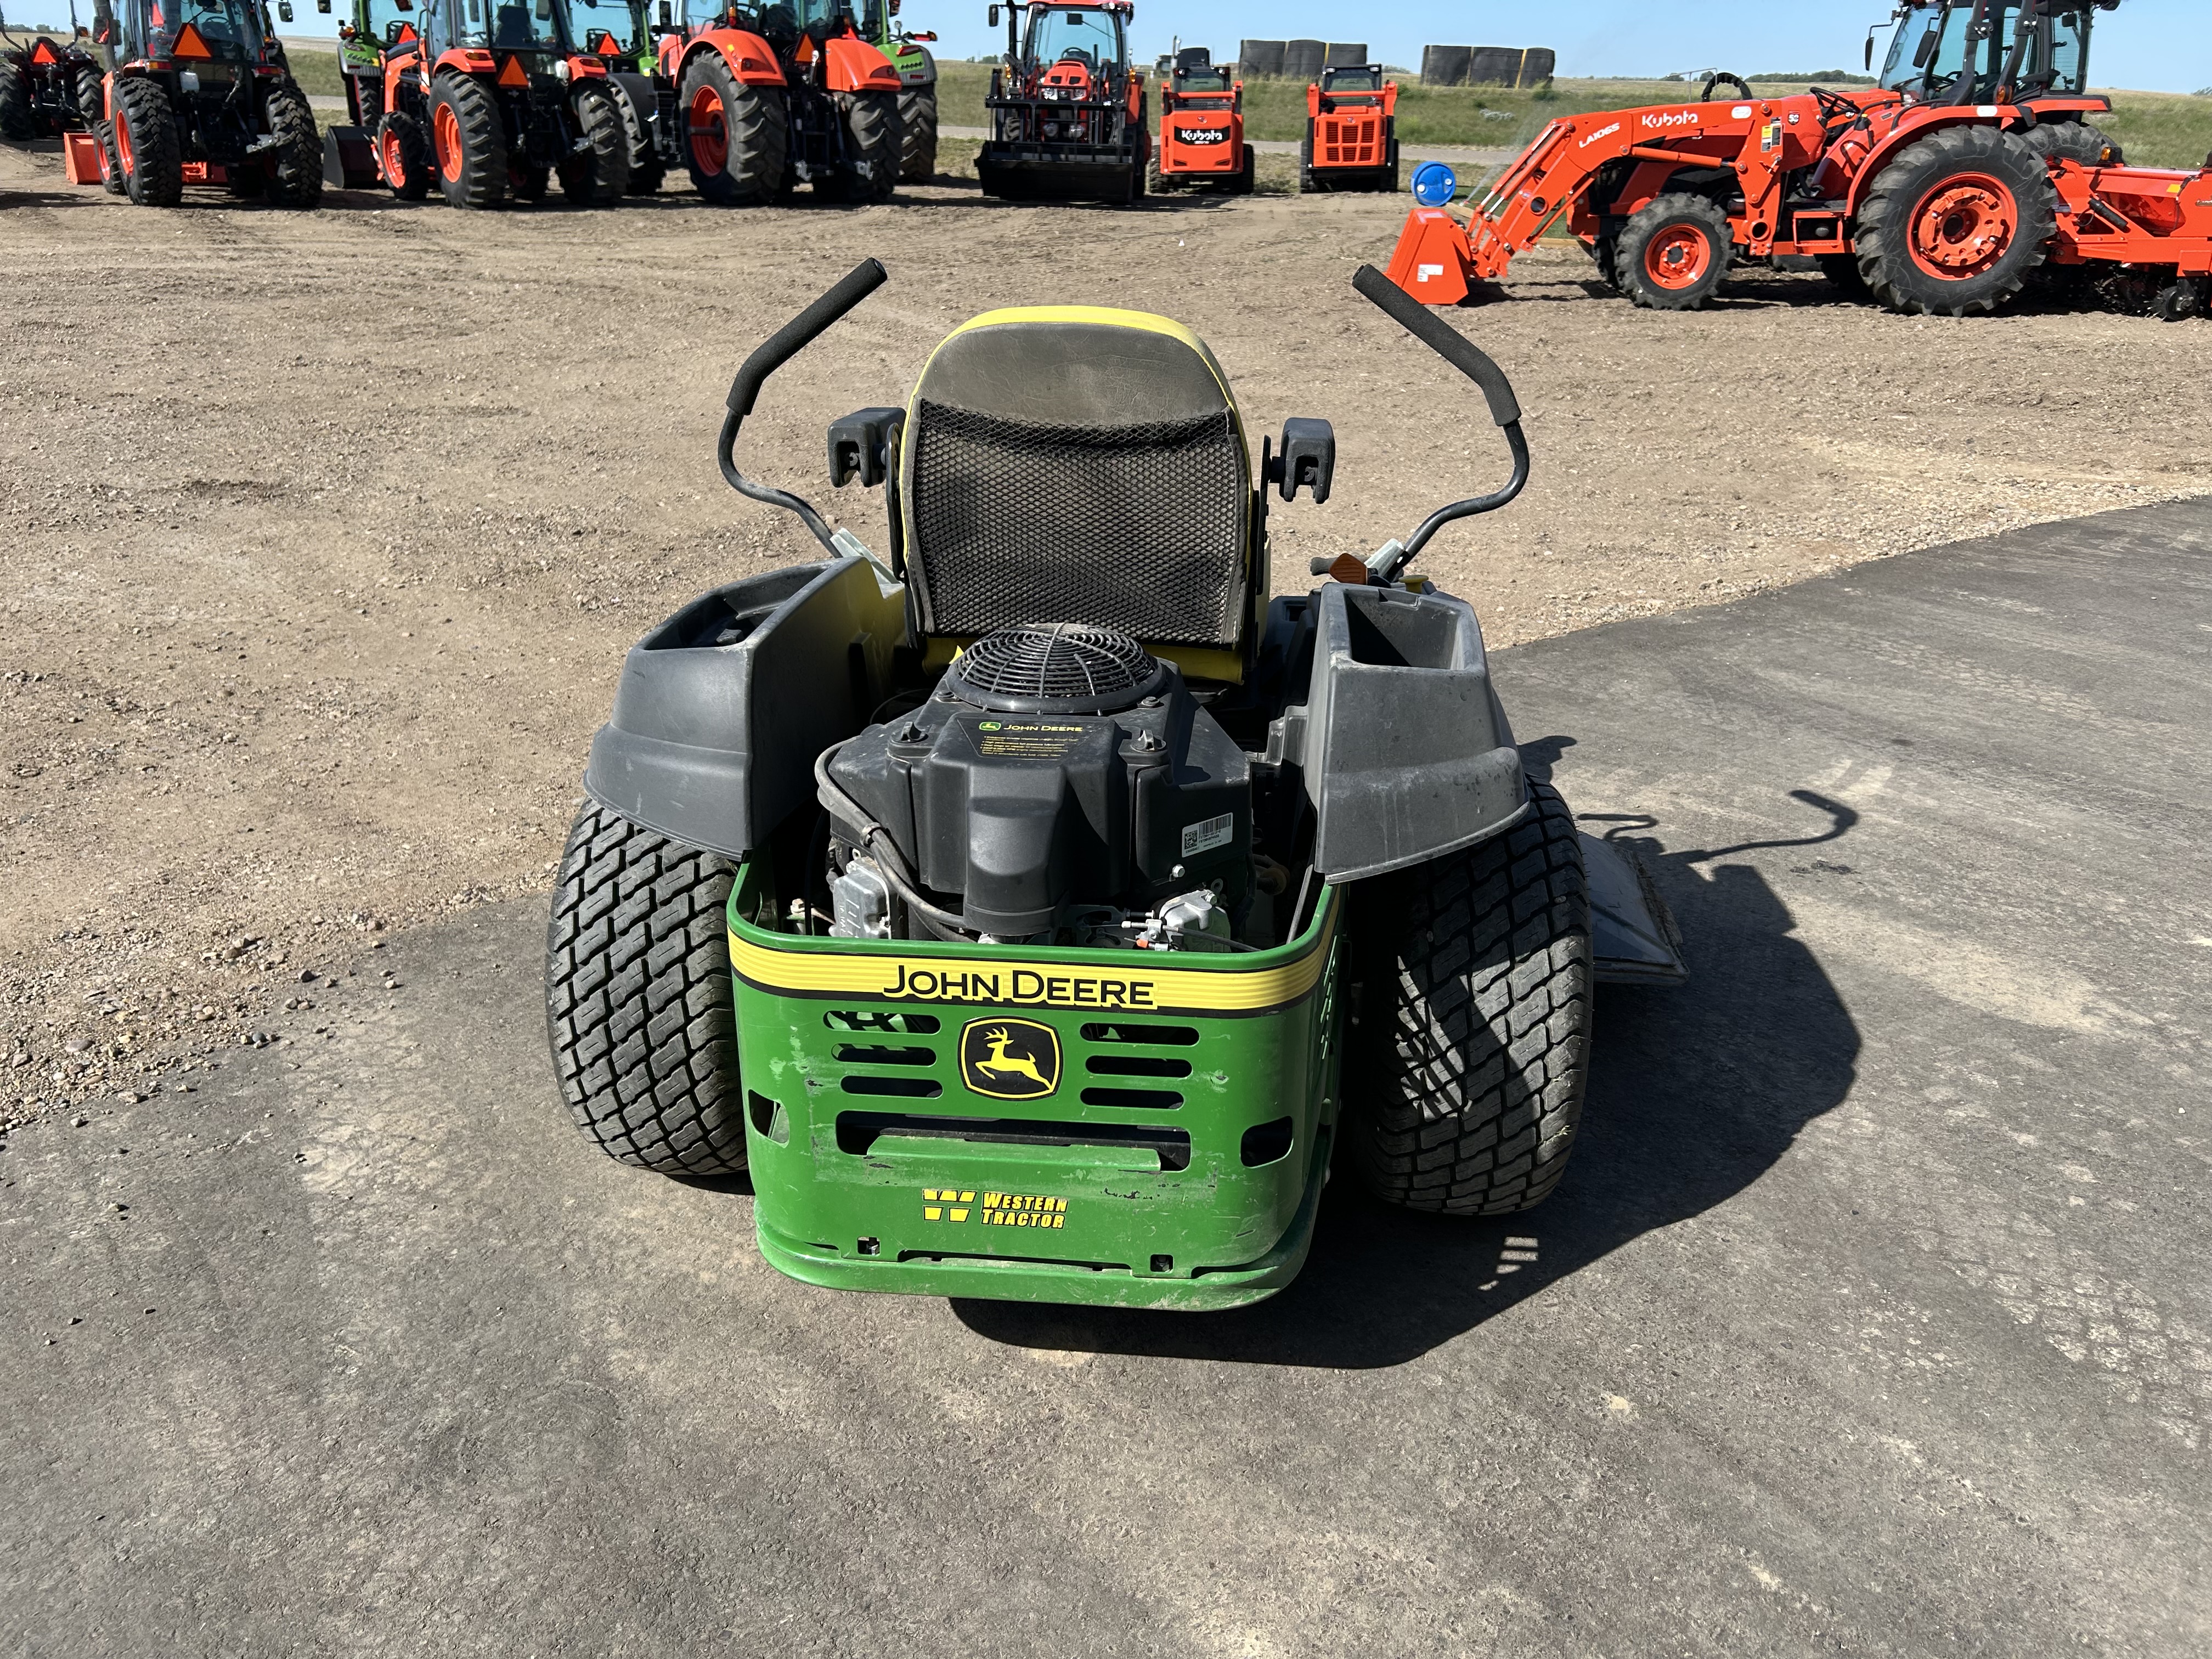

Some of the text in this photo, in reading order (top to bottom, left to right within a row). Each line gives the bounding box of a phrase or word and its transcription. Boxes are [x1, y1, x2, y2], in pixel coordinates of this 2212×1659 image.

[1642, 110, 1698, 128] Kubota
[1181, 129, 1222, 140] Kubota
[883, 964, 1154, 1006] JOHN DEERE
[983, 1192, 1068, 1212] WESTERN
[981, 1209, 1065, 1229] TRACTOR
